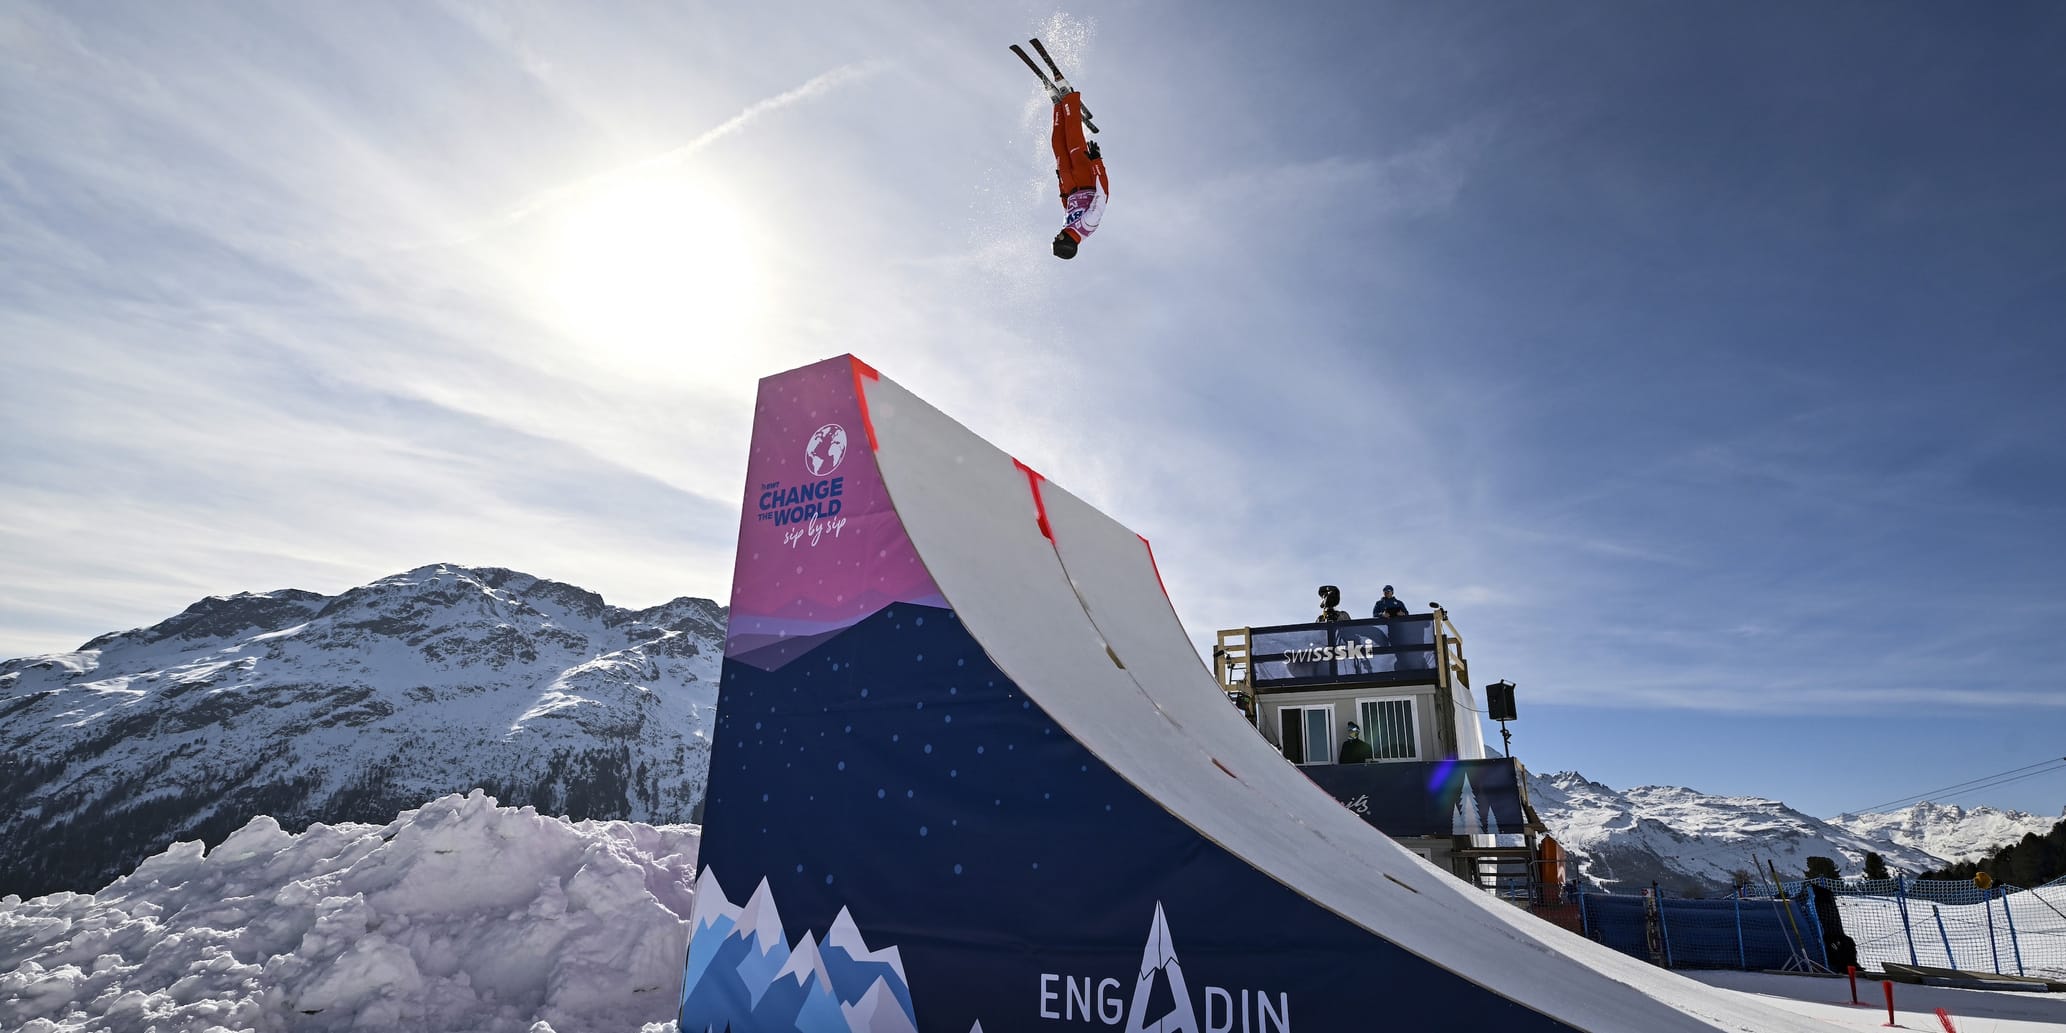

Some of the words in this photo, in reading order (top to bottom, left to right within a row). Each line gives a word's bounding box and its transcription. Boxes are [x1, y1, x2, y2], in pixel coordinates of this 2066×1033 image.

[759, 477, 844, 510] CHANGE
[758, 511, 773, 521] THE
[774, 500, 842, 527] WORLD
[783, 527, 804, 549] sip
[808, 511, 823, 547] by
[826, 515, 847, 538] sip
[1282, 638, 1374, 665] swissski
[1040, 899, 1290, 1033] ENGADIN
